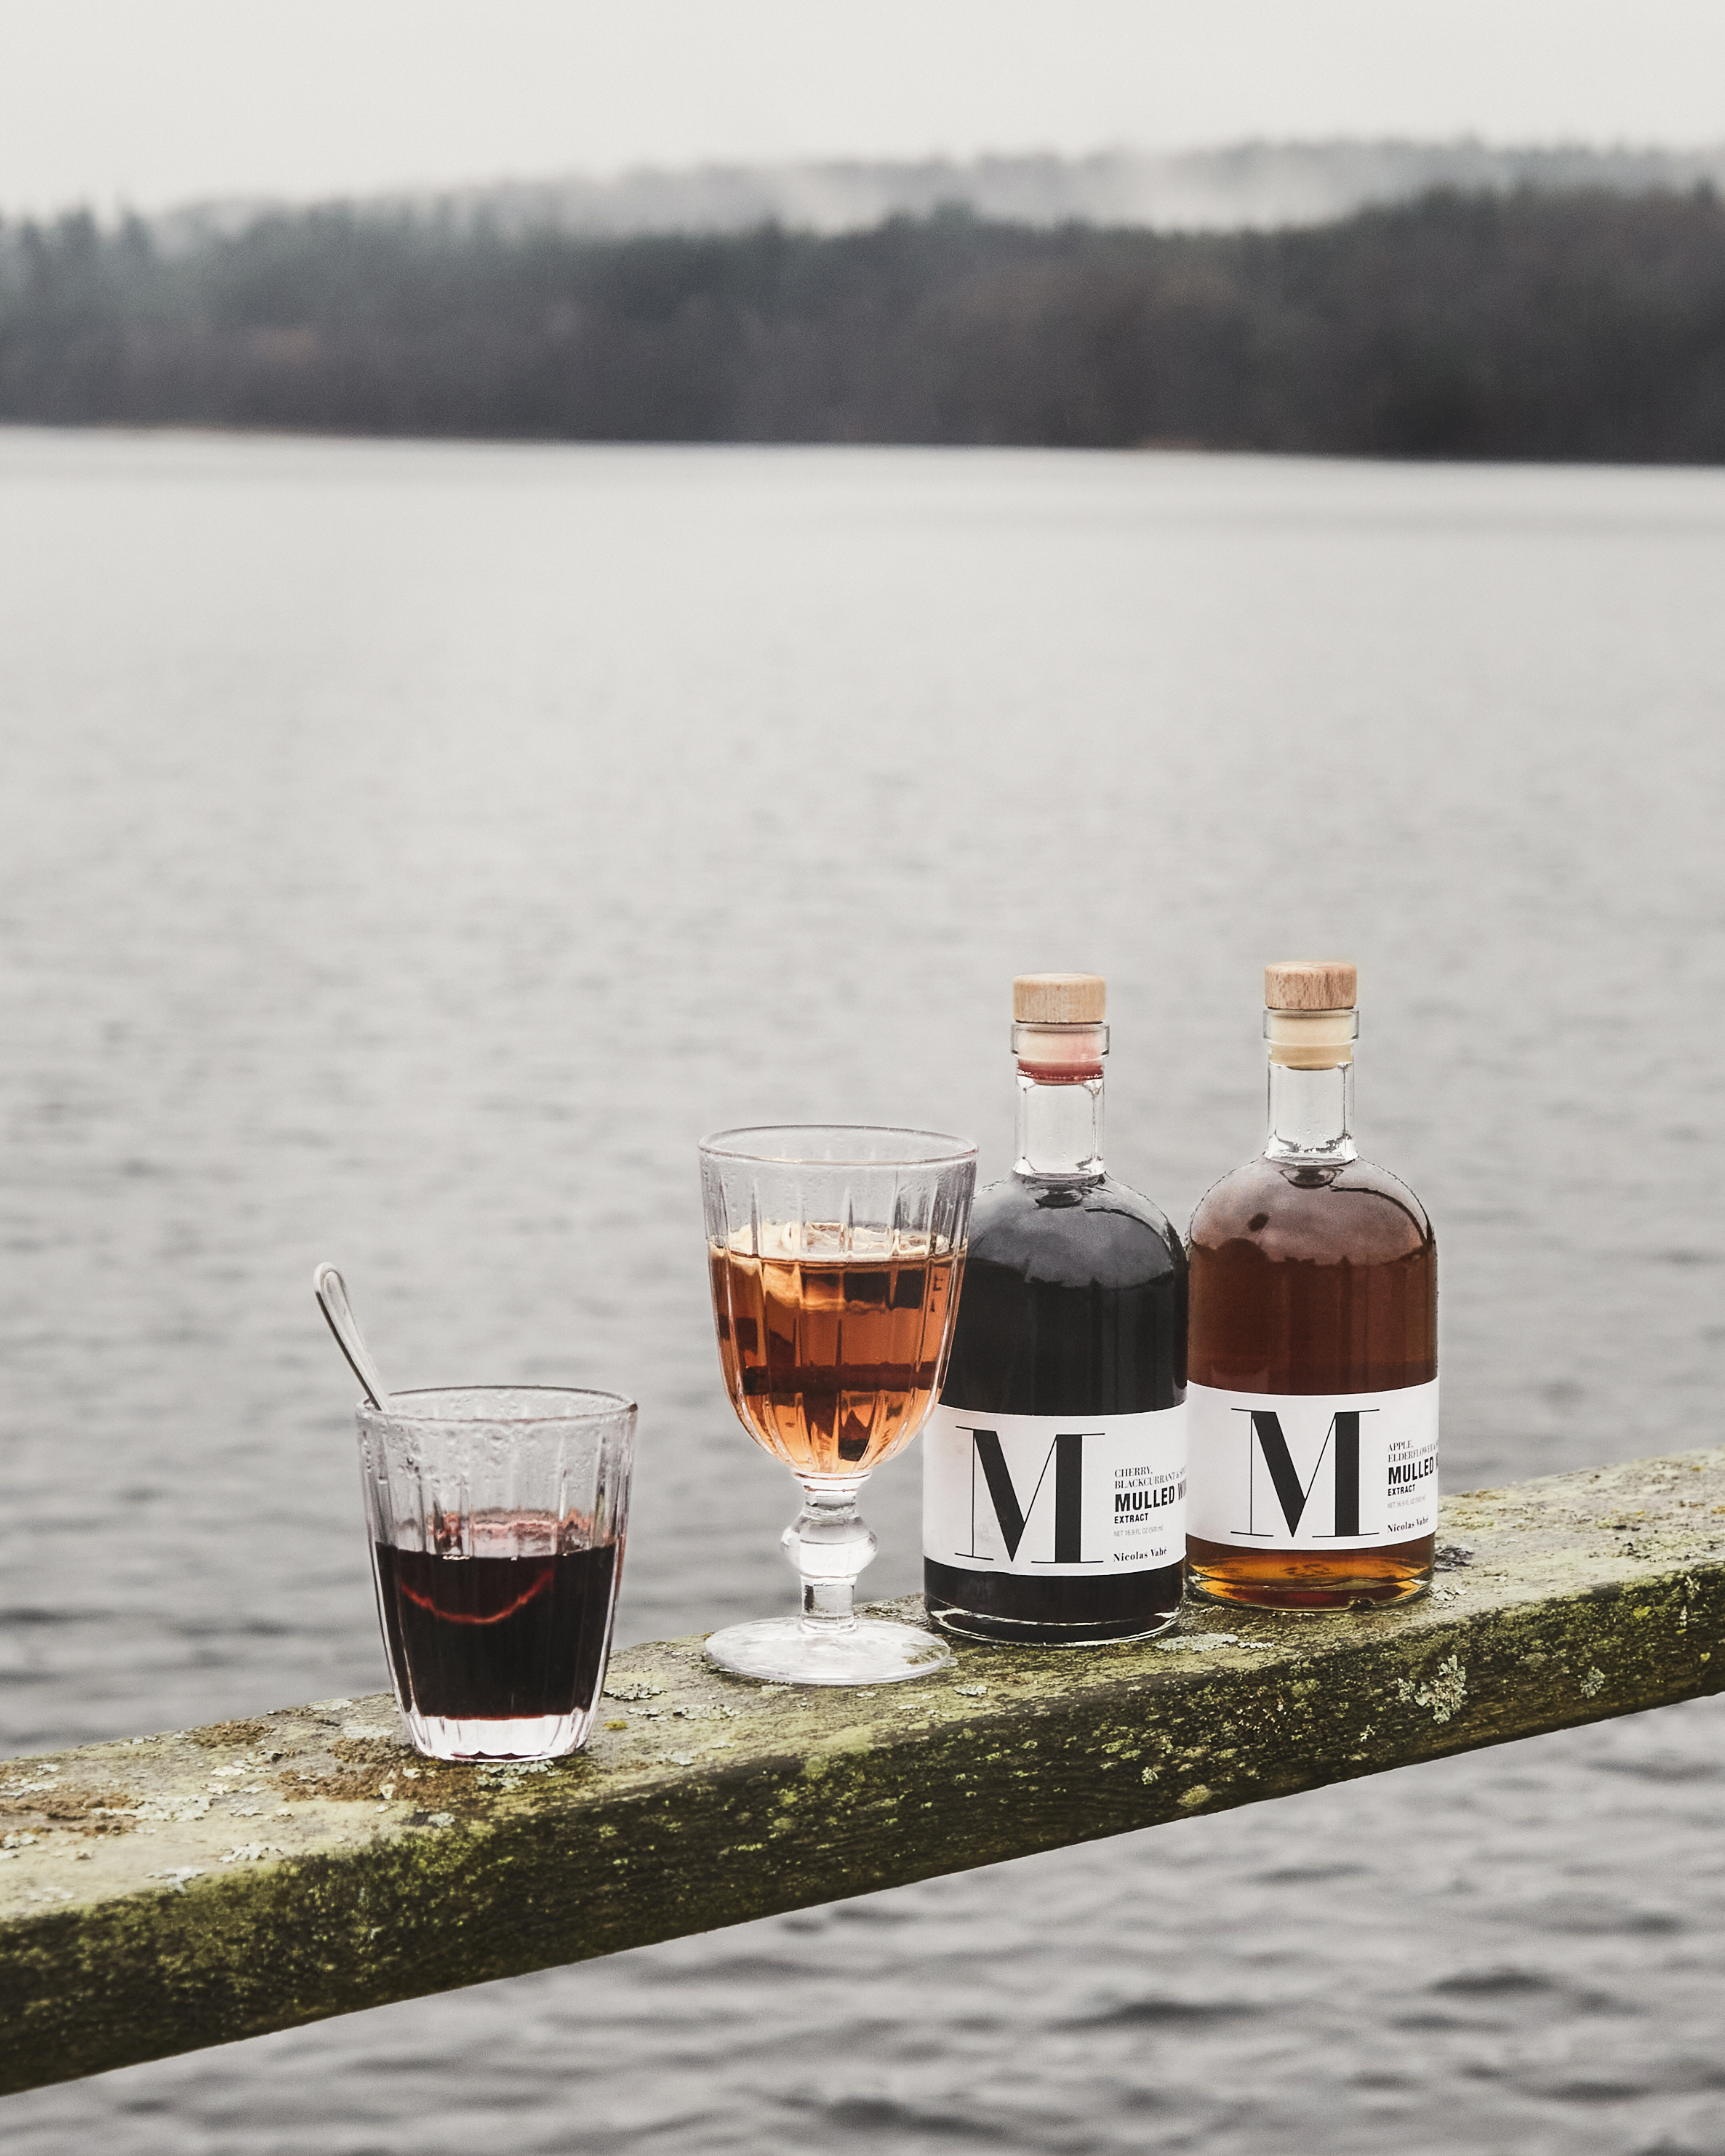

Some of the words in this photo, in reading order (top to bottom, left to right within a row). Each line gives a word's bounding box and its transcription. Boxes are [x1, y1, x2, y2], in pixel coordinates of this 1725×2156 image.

[1230, 1408, 1380, 1537] M
[1388, 1456, 1434, 1485] MULLED
[1115, 1471, 1175, 1489] BLACKCURRANT
[955, 1425, 1105, 1563] M
[1115, 1485, 1174, 1512] MULLED
[1388, 1483, 1415, 1496] EXTRACT
[1114, 1512, 1148, 1524] EXTRACT
[1388, 1521, 1414, 1533] Nicolas
[1113, 1551, 1148, 1563] Nicolas
[1150, 1546, 1167, 1558] Vahé
